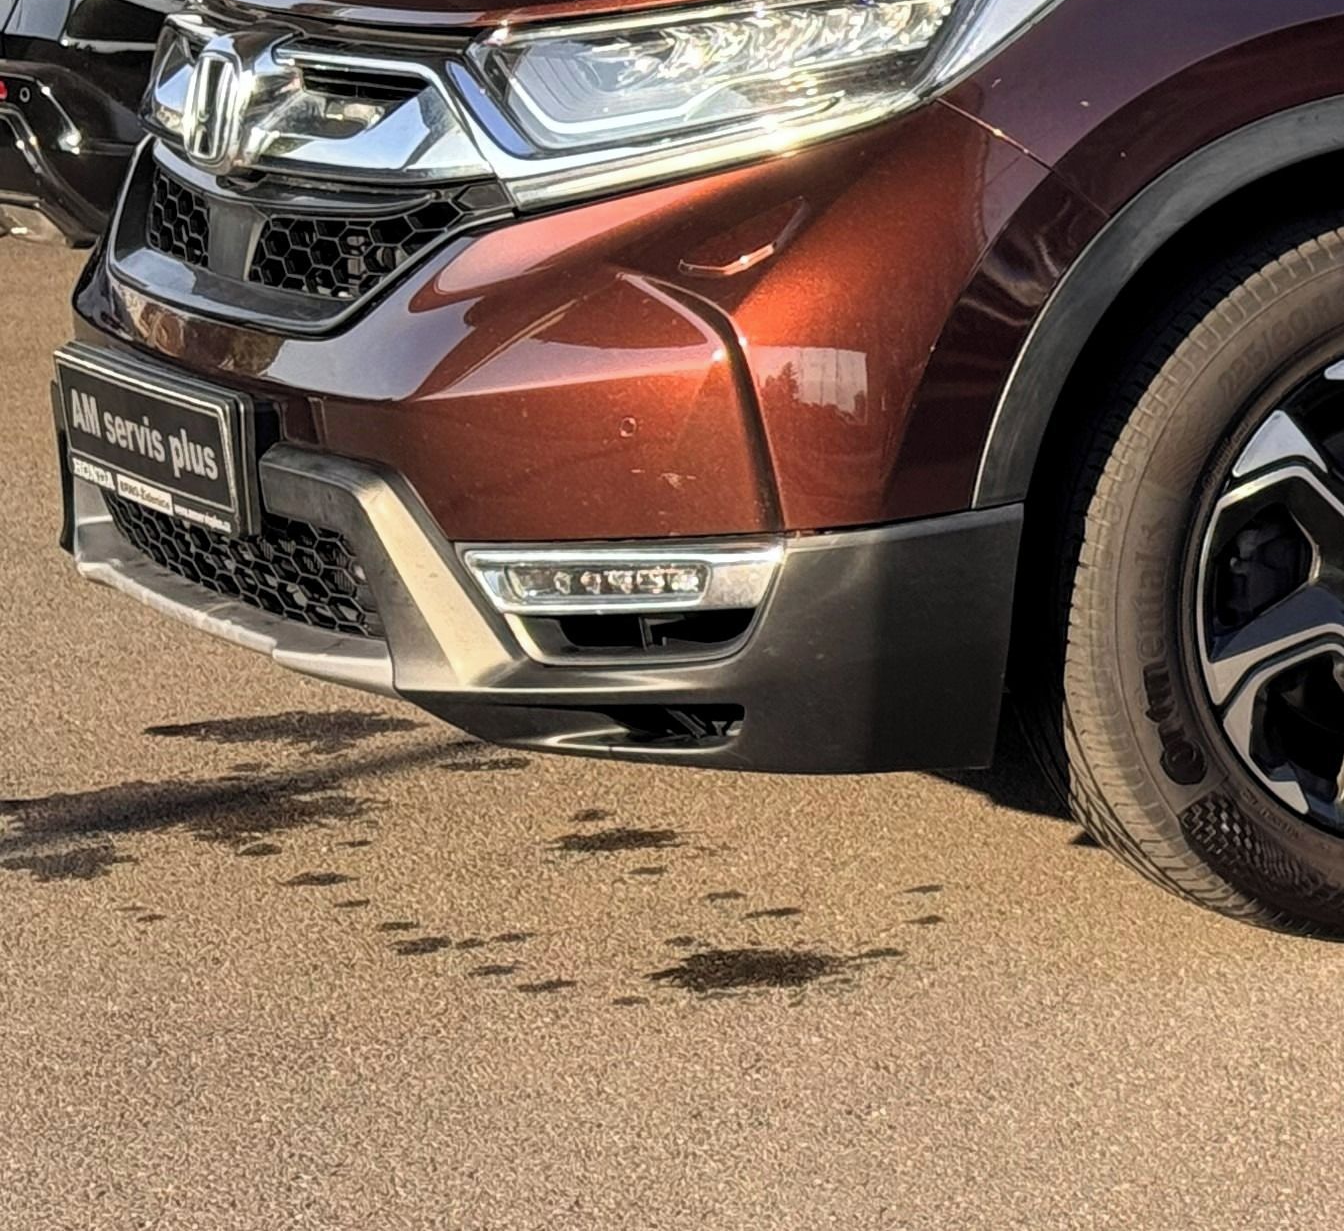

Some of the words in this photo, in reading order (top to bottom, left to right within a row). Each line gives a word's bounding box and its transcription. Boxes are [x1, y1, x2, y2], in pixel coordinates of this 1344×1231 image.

[71, 388, 101, 439] AM
[103, 411, 166, 463] servis
[168, 428, 218, 480] plus
